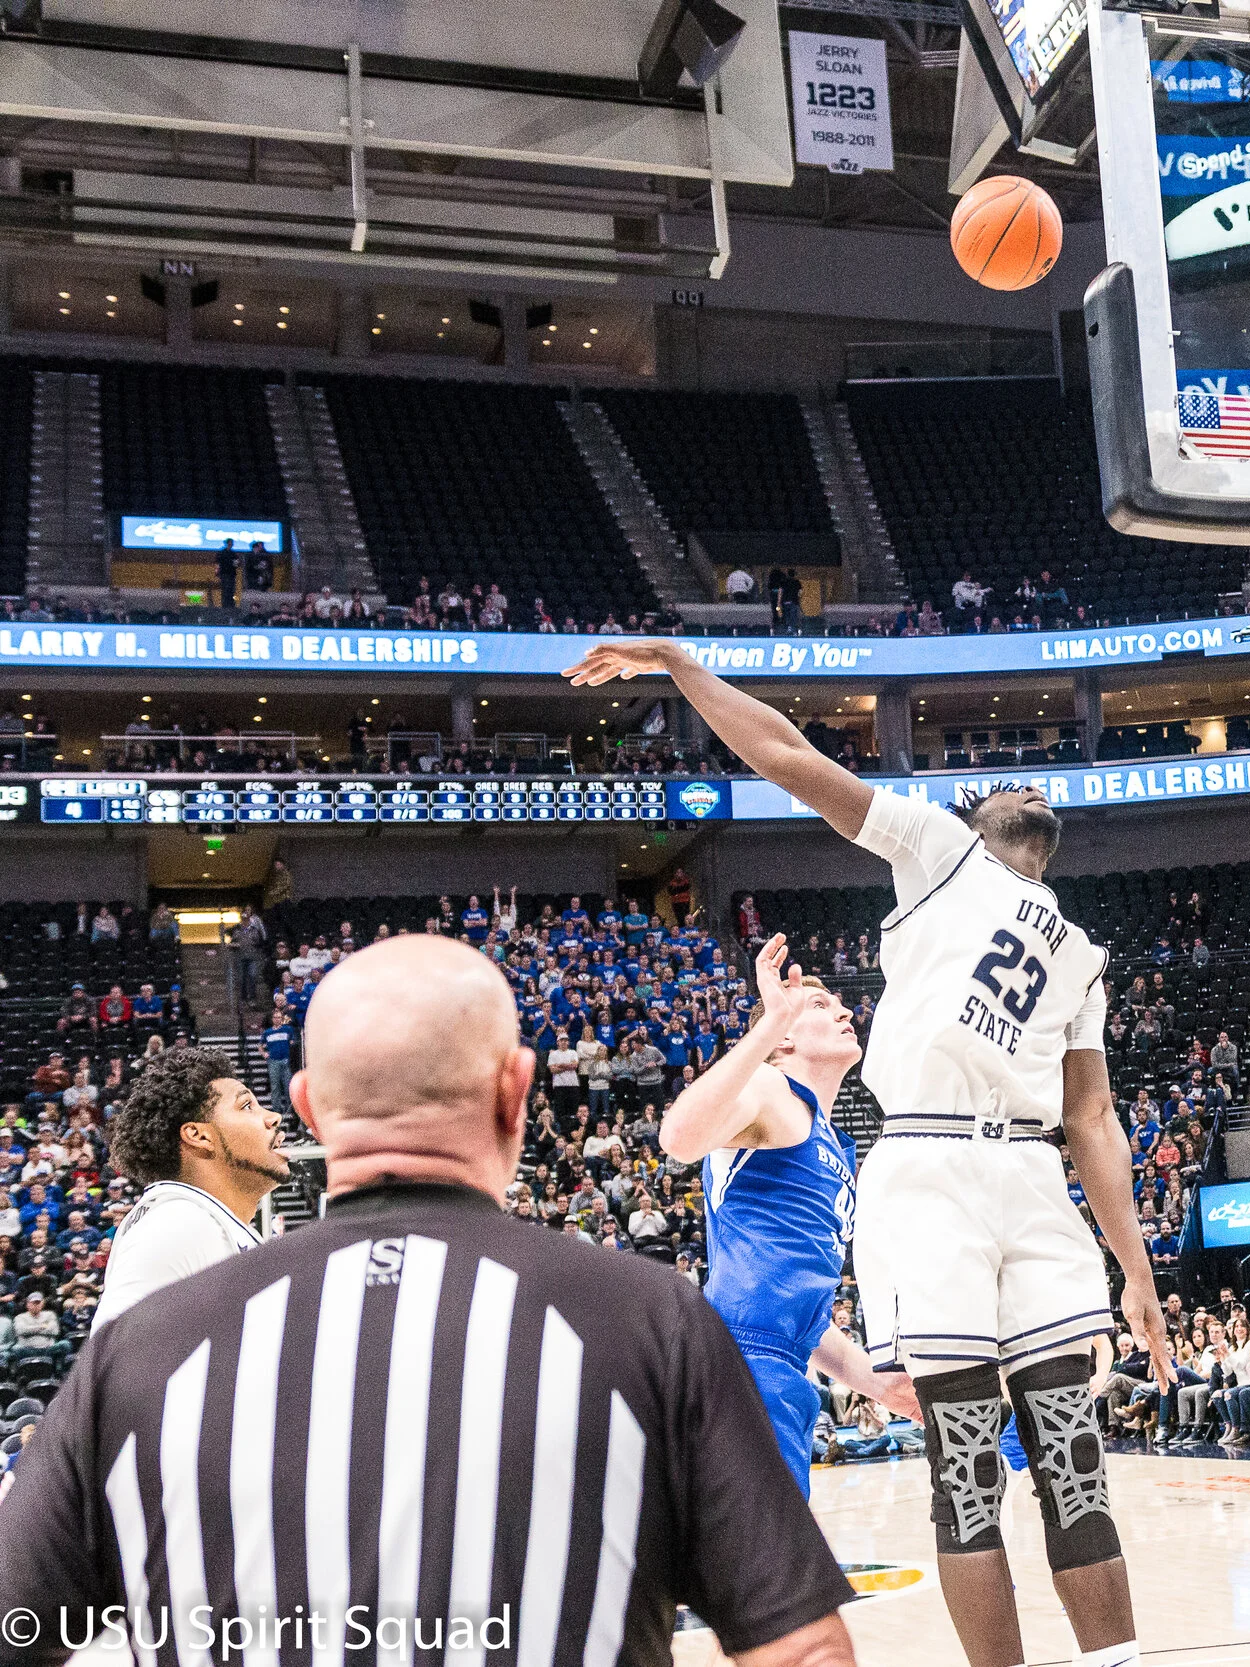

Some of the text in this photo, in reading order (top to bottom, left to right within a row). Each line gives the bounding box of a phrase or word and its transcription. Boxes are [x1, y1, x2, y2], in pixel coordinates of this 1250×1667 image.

[815, 44, 859, 60] JERRY
[815, 60, 862, 75] SLOAN
[806, 81, 876, 110] 1223
[811, 130, 875, 147] 1988-2011
[1182, 142, 1240, 175] Spend
[0, 630, 478, 664] LARRY H. MILLER DEALERSHIPS
[771, 645, 805, 672] By
[1041, 627, 1223, 661] LHMAUTO.COM
[1016, 899, 1068, 957] UTAH
[971, 929, 1047, 1024] 23
[958, 995, 1022, 1056] STATE
